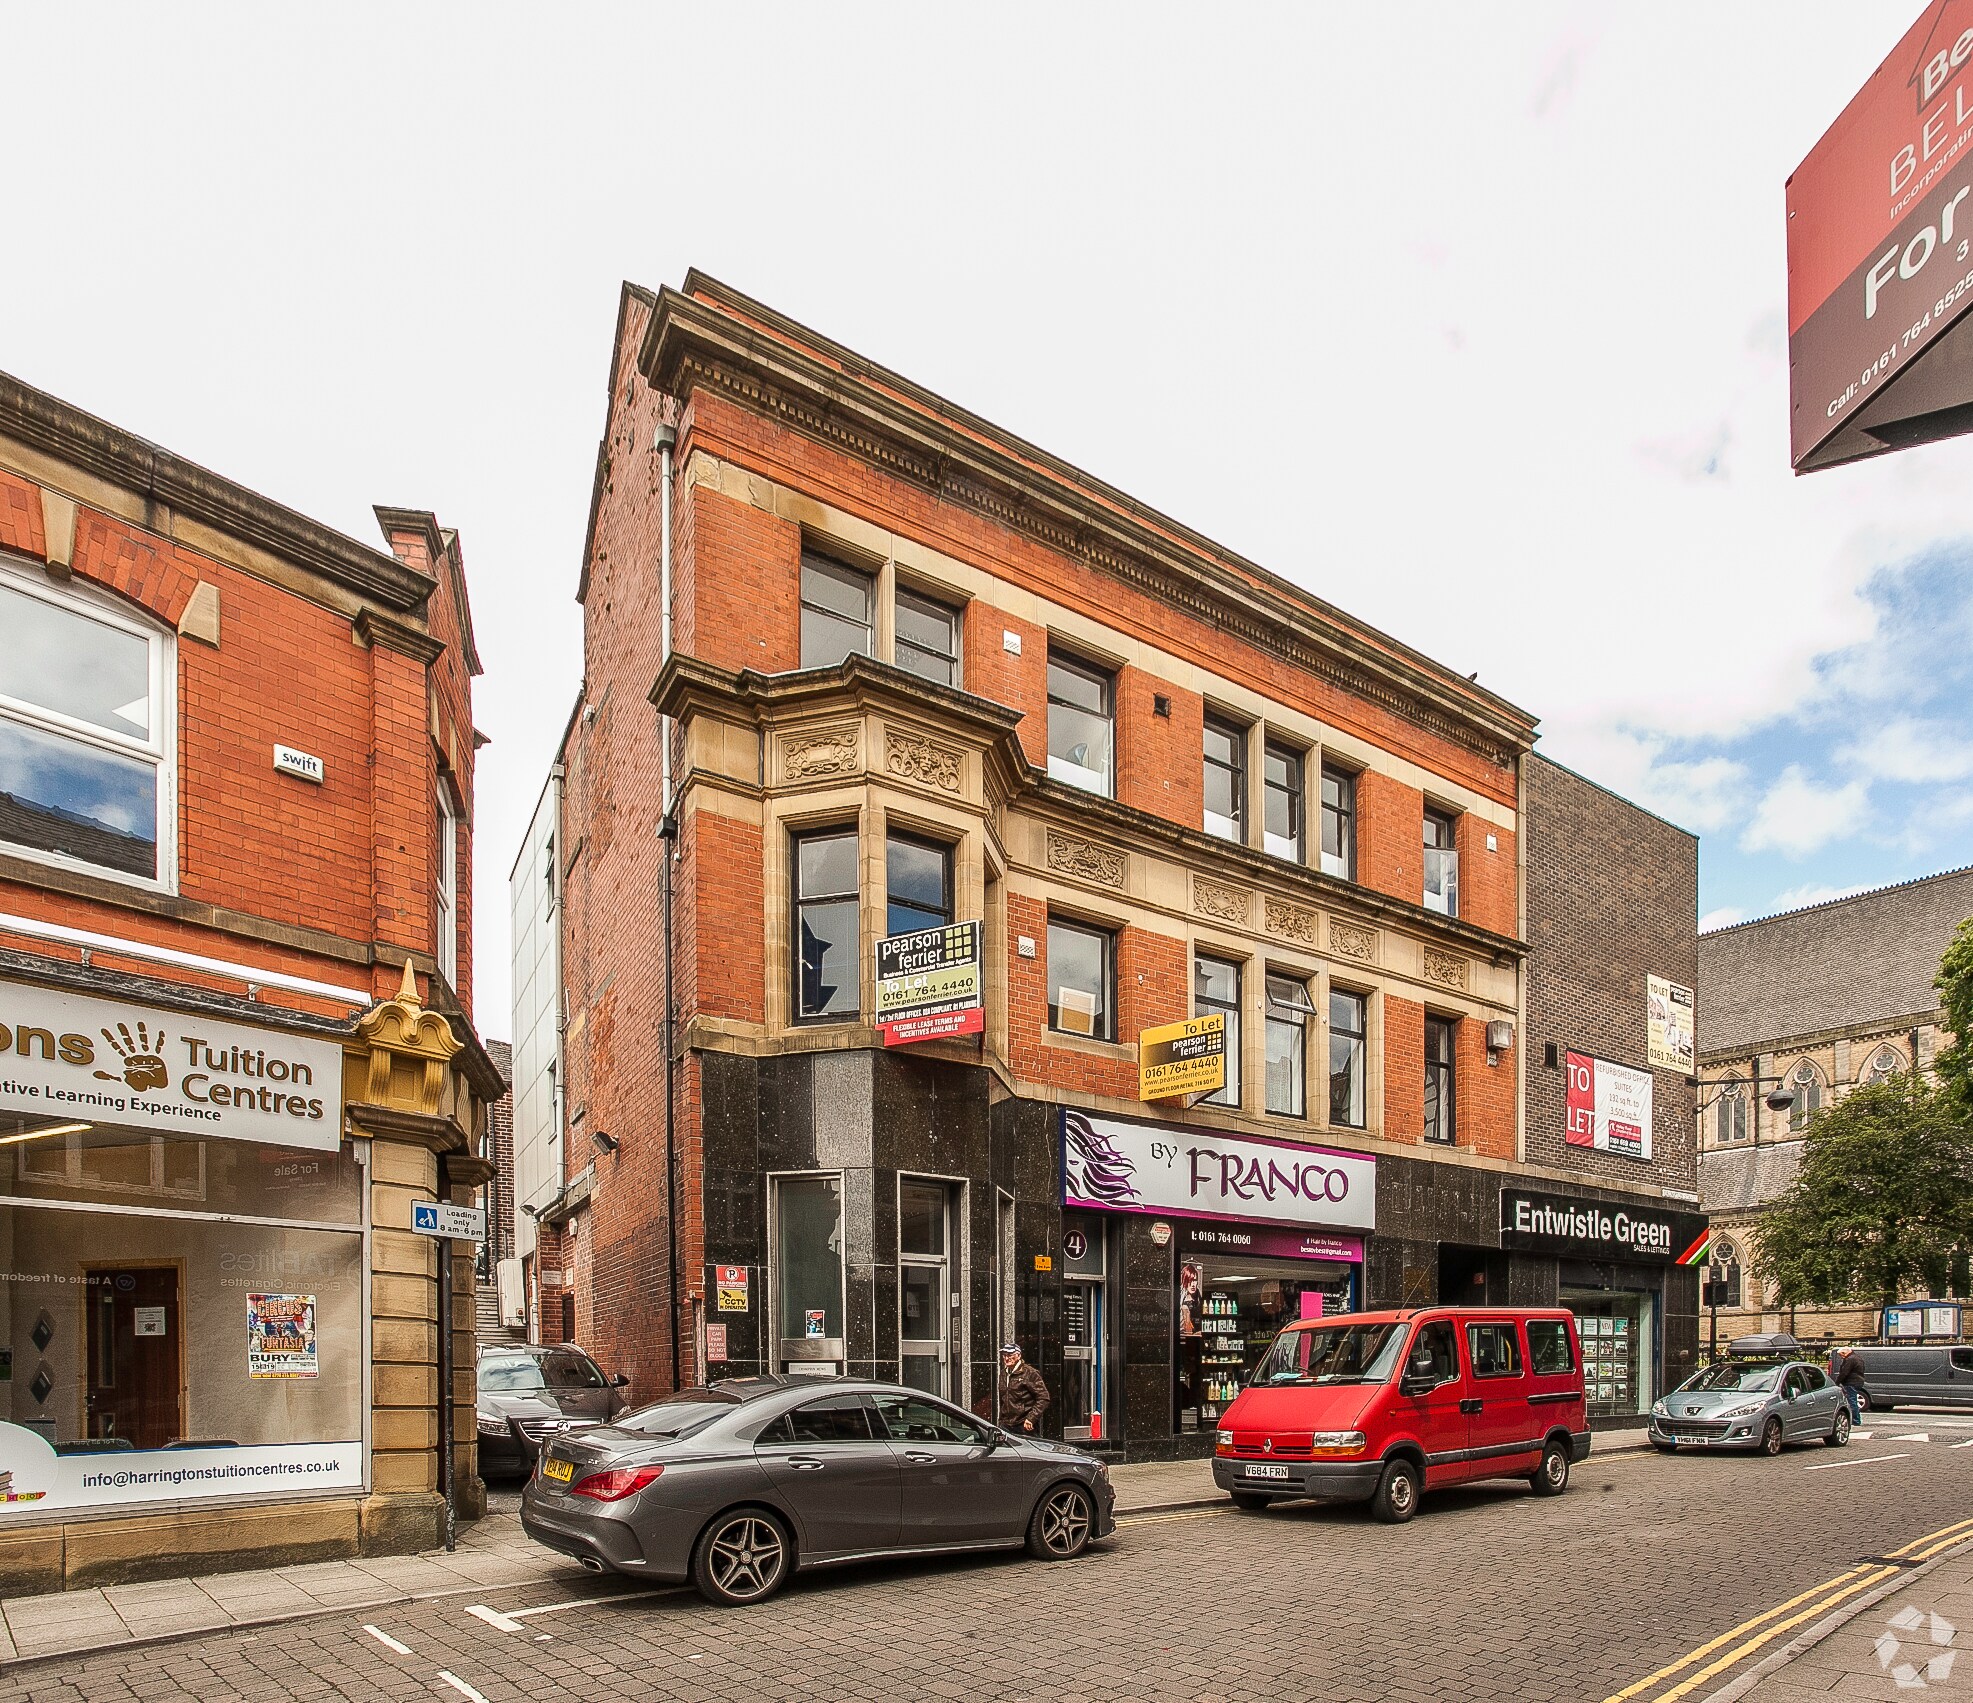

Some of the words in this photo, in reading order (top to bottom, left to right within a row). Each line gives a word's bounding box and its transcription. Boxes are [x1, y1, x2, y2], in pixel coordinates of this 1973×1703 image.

[1865, 185, 1970, 320] For
[1956, 238, 1970, 262] 3
[1826, 383, 1859, 418] Call:
[1861, 343, 1897, 386] 0161
[1902, 311, 1931, 348] 764
[282, 752, 317, 772] swift
[882, 931, 941, 961] pearson
[898, 947, 942, 970] ferrier
[882, 990, 909, 1001] 0161
[915, 985, 936, 997] 764
[941, 977, 974, 991] 4440
[883, 980, 899, 993] To
[904, 974, 928, 990] Let
[1649, 983, 1658, 994] TO
[1658, 986, 1668, 997] LET
[882, 987, 973, 1007] www.pearsonferrier.co.uk
[892, 1022, 916, 1032] FLEXIBLE
[917, 1019, 933, 1028] LEASE
[934, 1017, 953, 1025] TERMS
[953, 1015, 965, 1023] AND
[899, 1029, 930, 1038] INCENTIVES
[930, 1024, 958, 1034] AVAILABLE
[1183, 1023, 1197, 1035] To
[1202, 1018, 1221, 1032] Let
[1172, 1035, 1206, 1052] pearson
[1180, 1044, 1207, 1057] ferrier
[180, 1035, 313, 1086] Tuition
[1145, 1065, 1167, 1079] 0161
[1169, 1062, 1188, 1075] 764
[1191, 1056, 1219, 1070] 4440
[1649, 1048, 1664, 1061] 0161
[1665, 1052, 1677, 1064] 764
[1677, 1056, 1692, 1069] 4440
[1566, 1063, 1590, 1092] TO
[1595, 1063, 1632, 1080] REFURBISHED
[1614, 1081, 1632, 1093] SUITES
[181, 1073, 324, 1120] Centres
[1147, 1087, 1165, 1095] GROUND
[1165, 1084, 1180, 1092] FLOOR
[0, 1080, 39, 1097] tive
[45, 1085, 126, 1111] Learning
[130, 1097, 222, 1122] Experience
[1567, 1105, 1595, 1135] LET
[1186, 1147, 1350, 1203] FRANCO
[446, 1209, 477, 1221] Loading
[453, 1219, 470, 1227] only
[1515, 1200, 1611, 1240] Entwistle
[1614, 1212, 1671, 1247] Green
[1067, 1234, 1081, 1254] 4
[1198, 1231, 1216, 1242] 0161
[1218, 1232, 1231, 1244] 764
[1232, 1234, 1251, 1245] 0060
[1633, 1244, 1647, 1252] SALES
[1650, 1246, 1670, 1255] LETTINGS
[257, 1297, 303, 1317] CIRCUS
[724, 1298, 746, 1306] CCTV
[261, 1336, 304, 1349] FUNTASIA
[250, 1353, 291, 1362] BURY
[82, 1459, 340, 1488] info@harringtonstuitioncentres.co.uk
[1246, 1466, 1268, 1477] V684
[1269, 1467, 1288, 1477] FRN
